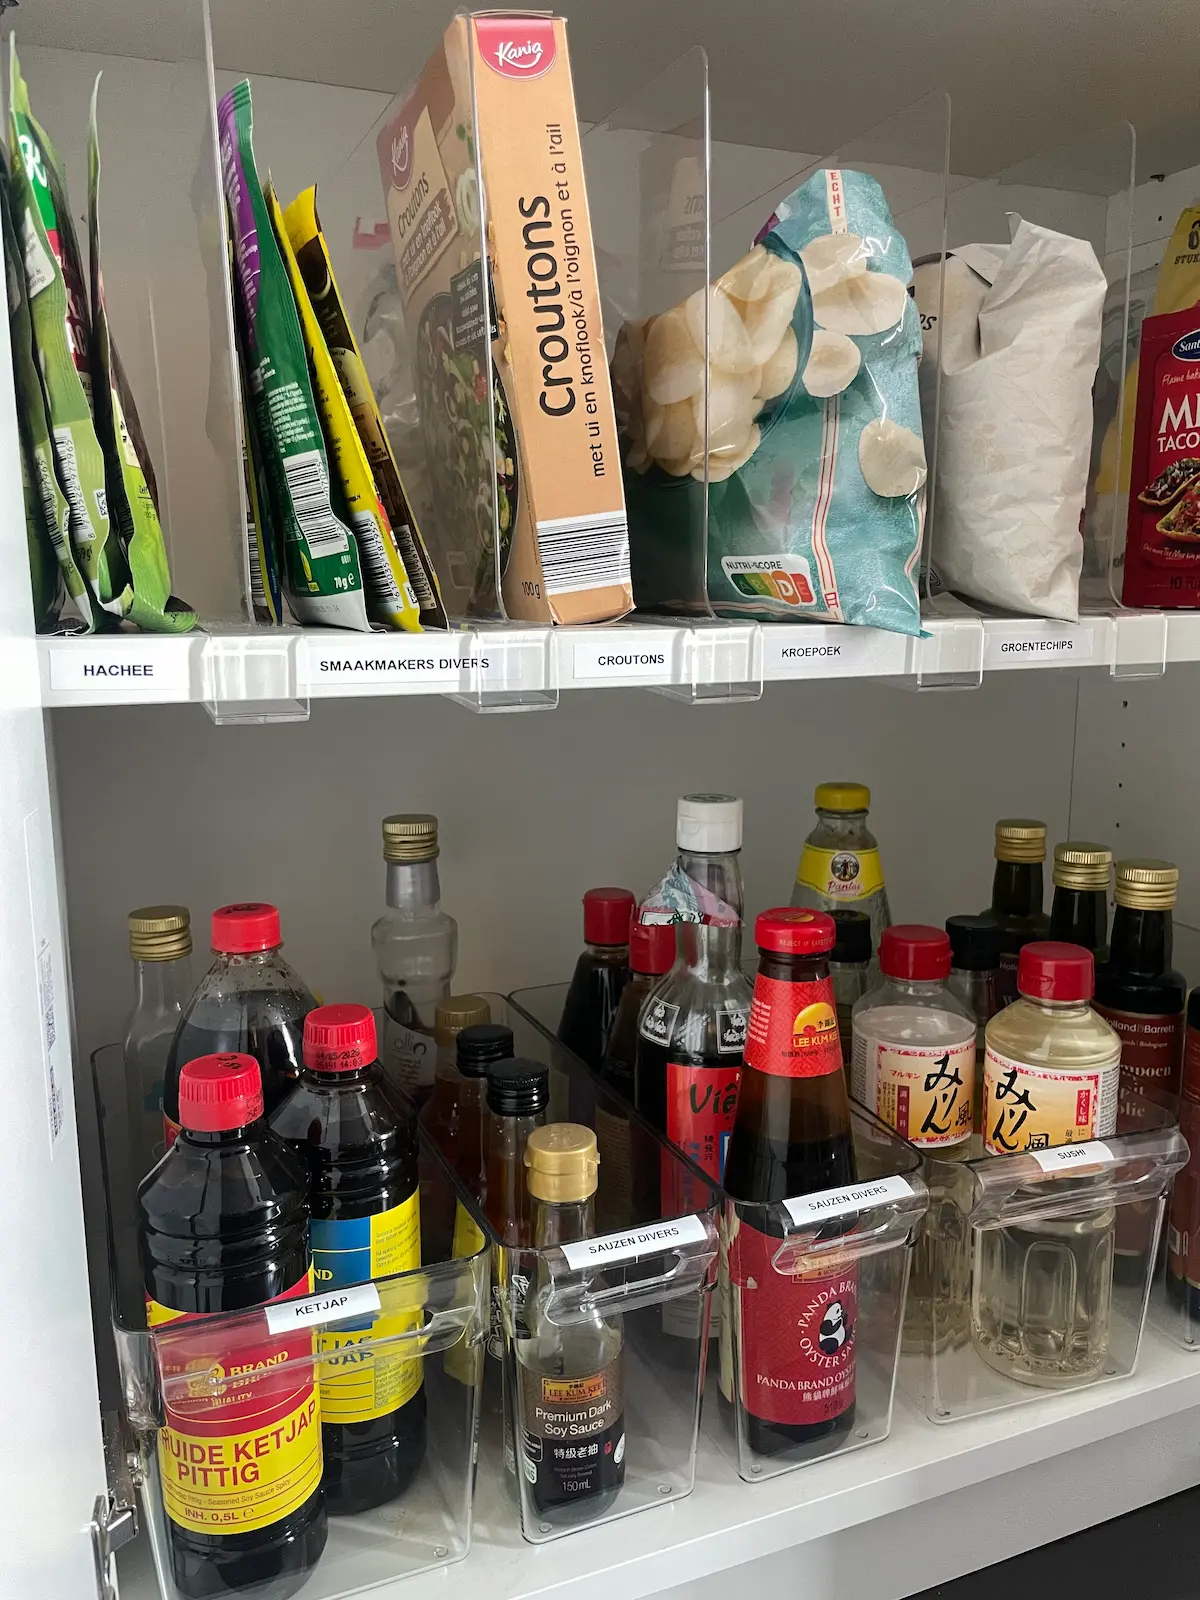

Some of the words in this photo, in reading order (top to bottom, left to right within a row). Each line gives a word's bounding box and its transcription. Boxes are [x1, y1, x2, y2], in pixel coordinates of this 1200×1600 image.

[493, 40, 543, 69] Kania
[546, 123, 564, 155] l'ail
[551, 162, 566, 174] à
[555, 180, 570, 201] et
[830, 171, 841, 217] ECHT
[561, 208, 580, 283] l'oignon
[518, 195, 576, 417] Croutons
[1162, 374, 1184, 387] Flame
[584, 391, 598, 414] en
[585, 421, 600, 437] ui
[589, 443, 605, 477] met
[776, 579, 794, 597] D
[797, 581, 810, 595] E
[781, 646, 842, 659] KROEPOEK
[1001, 640, 1074, 653] GROENTECHIPS
[319, 659, 435, 672] SMAAKMAKERS
[439, 658, 490, 670] DIVERS
[597, 654, 665, 666] CROUTONS
[83, 664, 154, 677] HACHEE
[1144, 1024, 1175, 1034] Barrett
[793, 1037, 811, 1048] LEE
[812, 1035, 828, 1046] KUM
[1057, 1149, 1087, 1160] SUSHI
[808, 1194, 851, 1212] SAUZEN
[852, 1185, 888, 1203] DIVERS
[588, 1233, 636, 1254] SAUZEN
[638, 1227, 680, 1243] DIVERS
[294, 1296, 348, 1317] KETJAP
[798, 1286, 837, 1327] PANDA
[800, 1337, 839, 1368] OYSTER
[229, 1350, 289, 1377] BRAND
[757, 1374, 796, 1391] PANDA
[798, 1376, 834, 1391] BRAND
[549, 1388, 562, 1397] LEE
[566, 1388, 586, 1397] KUM
[535, 1407, 587, 1422] Premium
[588, 1400, 611, 1417] Dark
[234, 1400, 316, 1463] KETJAP
[544, 1423, 568, 1437] Soy
[569, 1419, 604, 1435] Sauce
[553, 1443, 599, 1459] 特級老抽
[178, 1462, 260, 1487] PITTIG
[208, 1497, 240, 1506] Seasoned
[241, 1493, 253, 1504] Soy
[255, 1487, 275, 1499] Sauce
[275, 1478, 291, 1491] Spicy
[562, 1479, 591, 1491] 150mL
[184, 1507, 207, 1521] INH.
[211, 1513, 239, 1523] 0,5L
